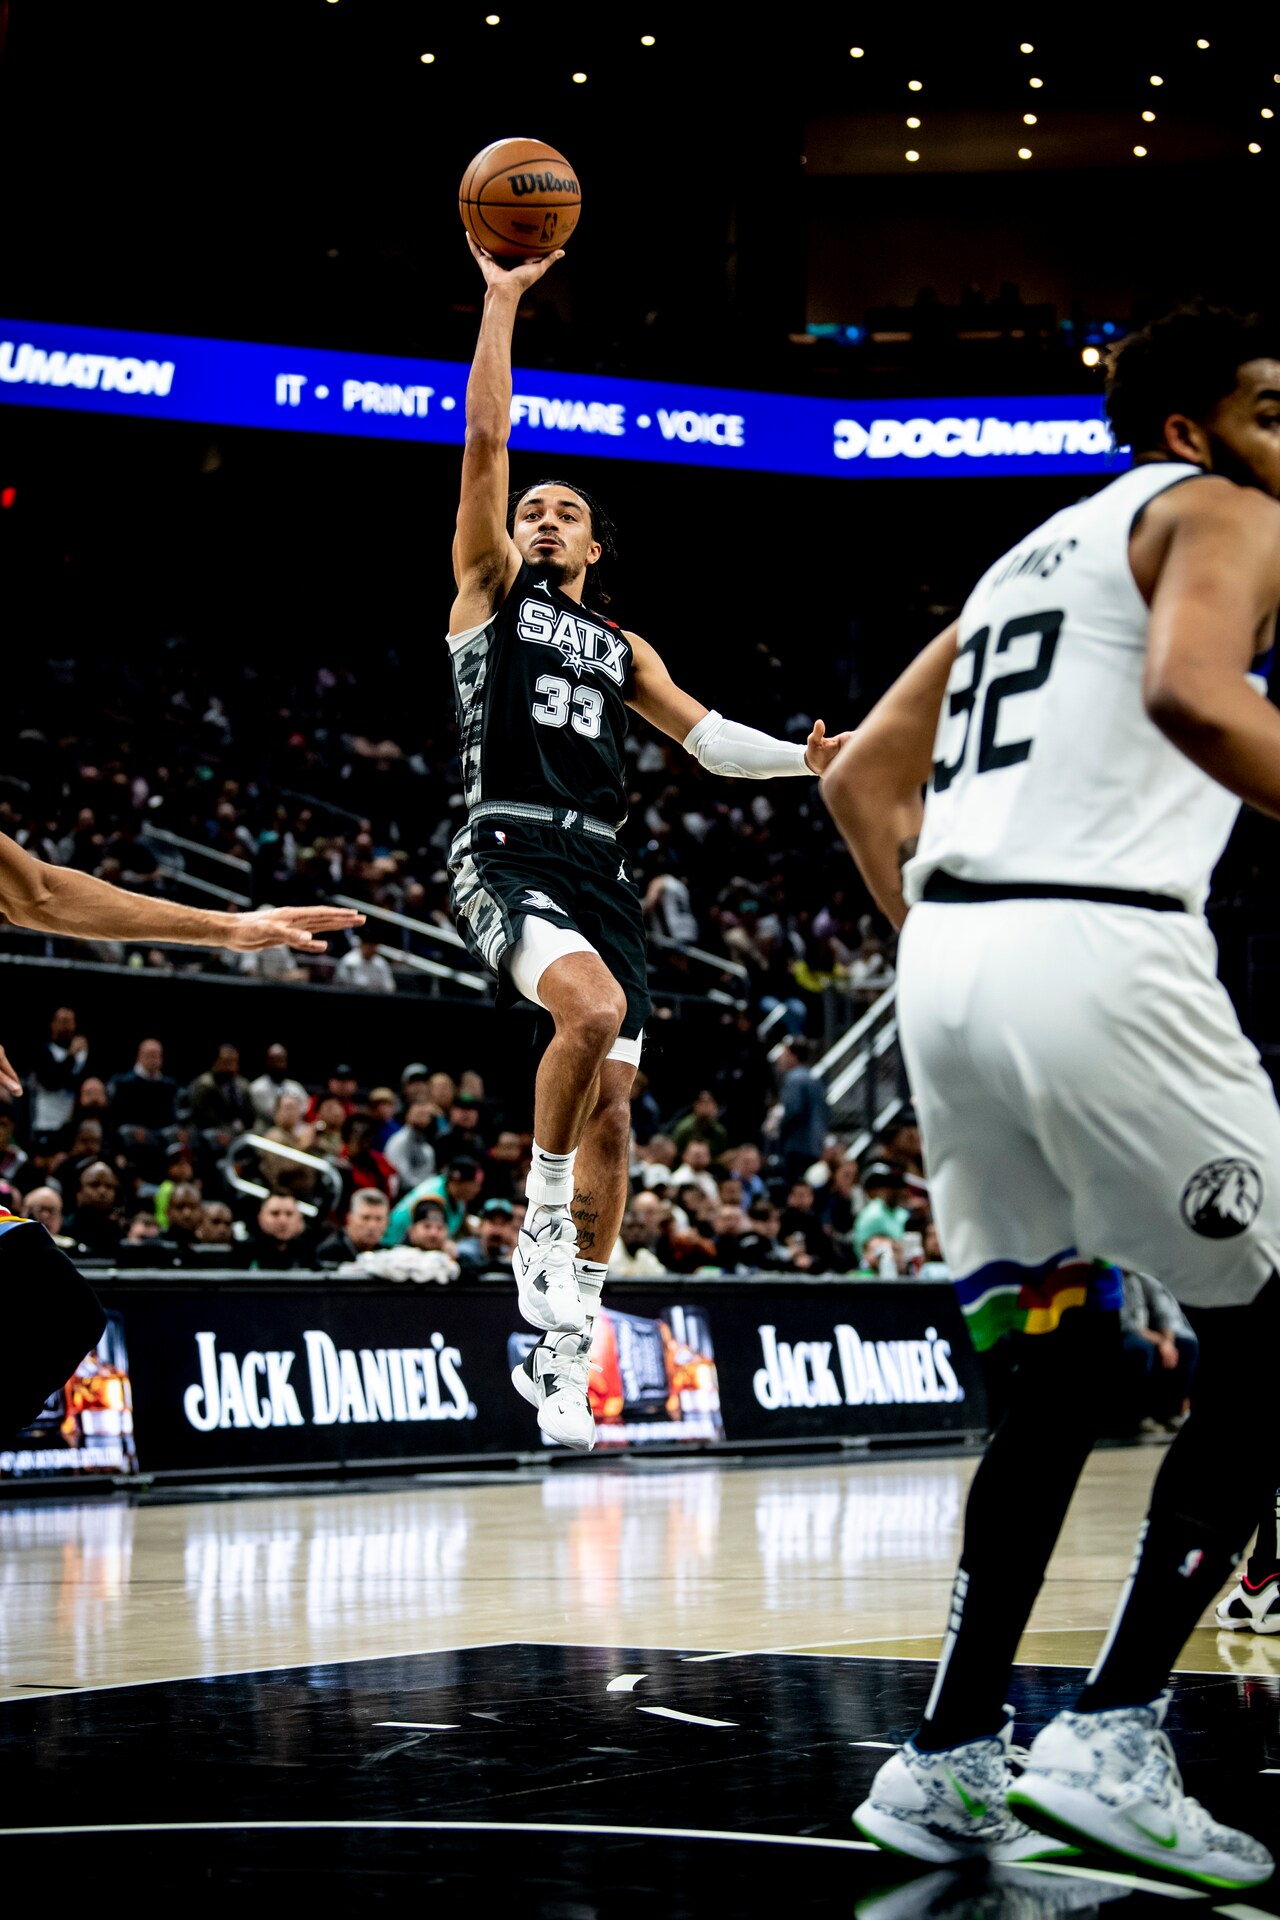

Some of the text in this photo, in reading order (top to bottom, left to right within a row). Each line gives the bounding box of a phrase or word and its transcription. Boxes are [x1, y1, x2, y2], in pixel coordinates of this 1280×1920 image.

[507, 171, 580, 197] Wilson
[275, 374, 744, 447] IT PRINT FTWARE VOICE
[865, 417, 1131, 459] DOCUMATIO
[517, 597, 628, 686] SATX
[532, 674, 604, 739] 33
[183, 1331, 304, 1431] JACK
[753, 1324, 842, 1410] JACK
